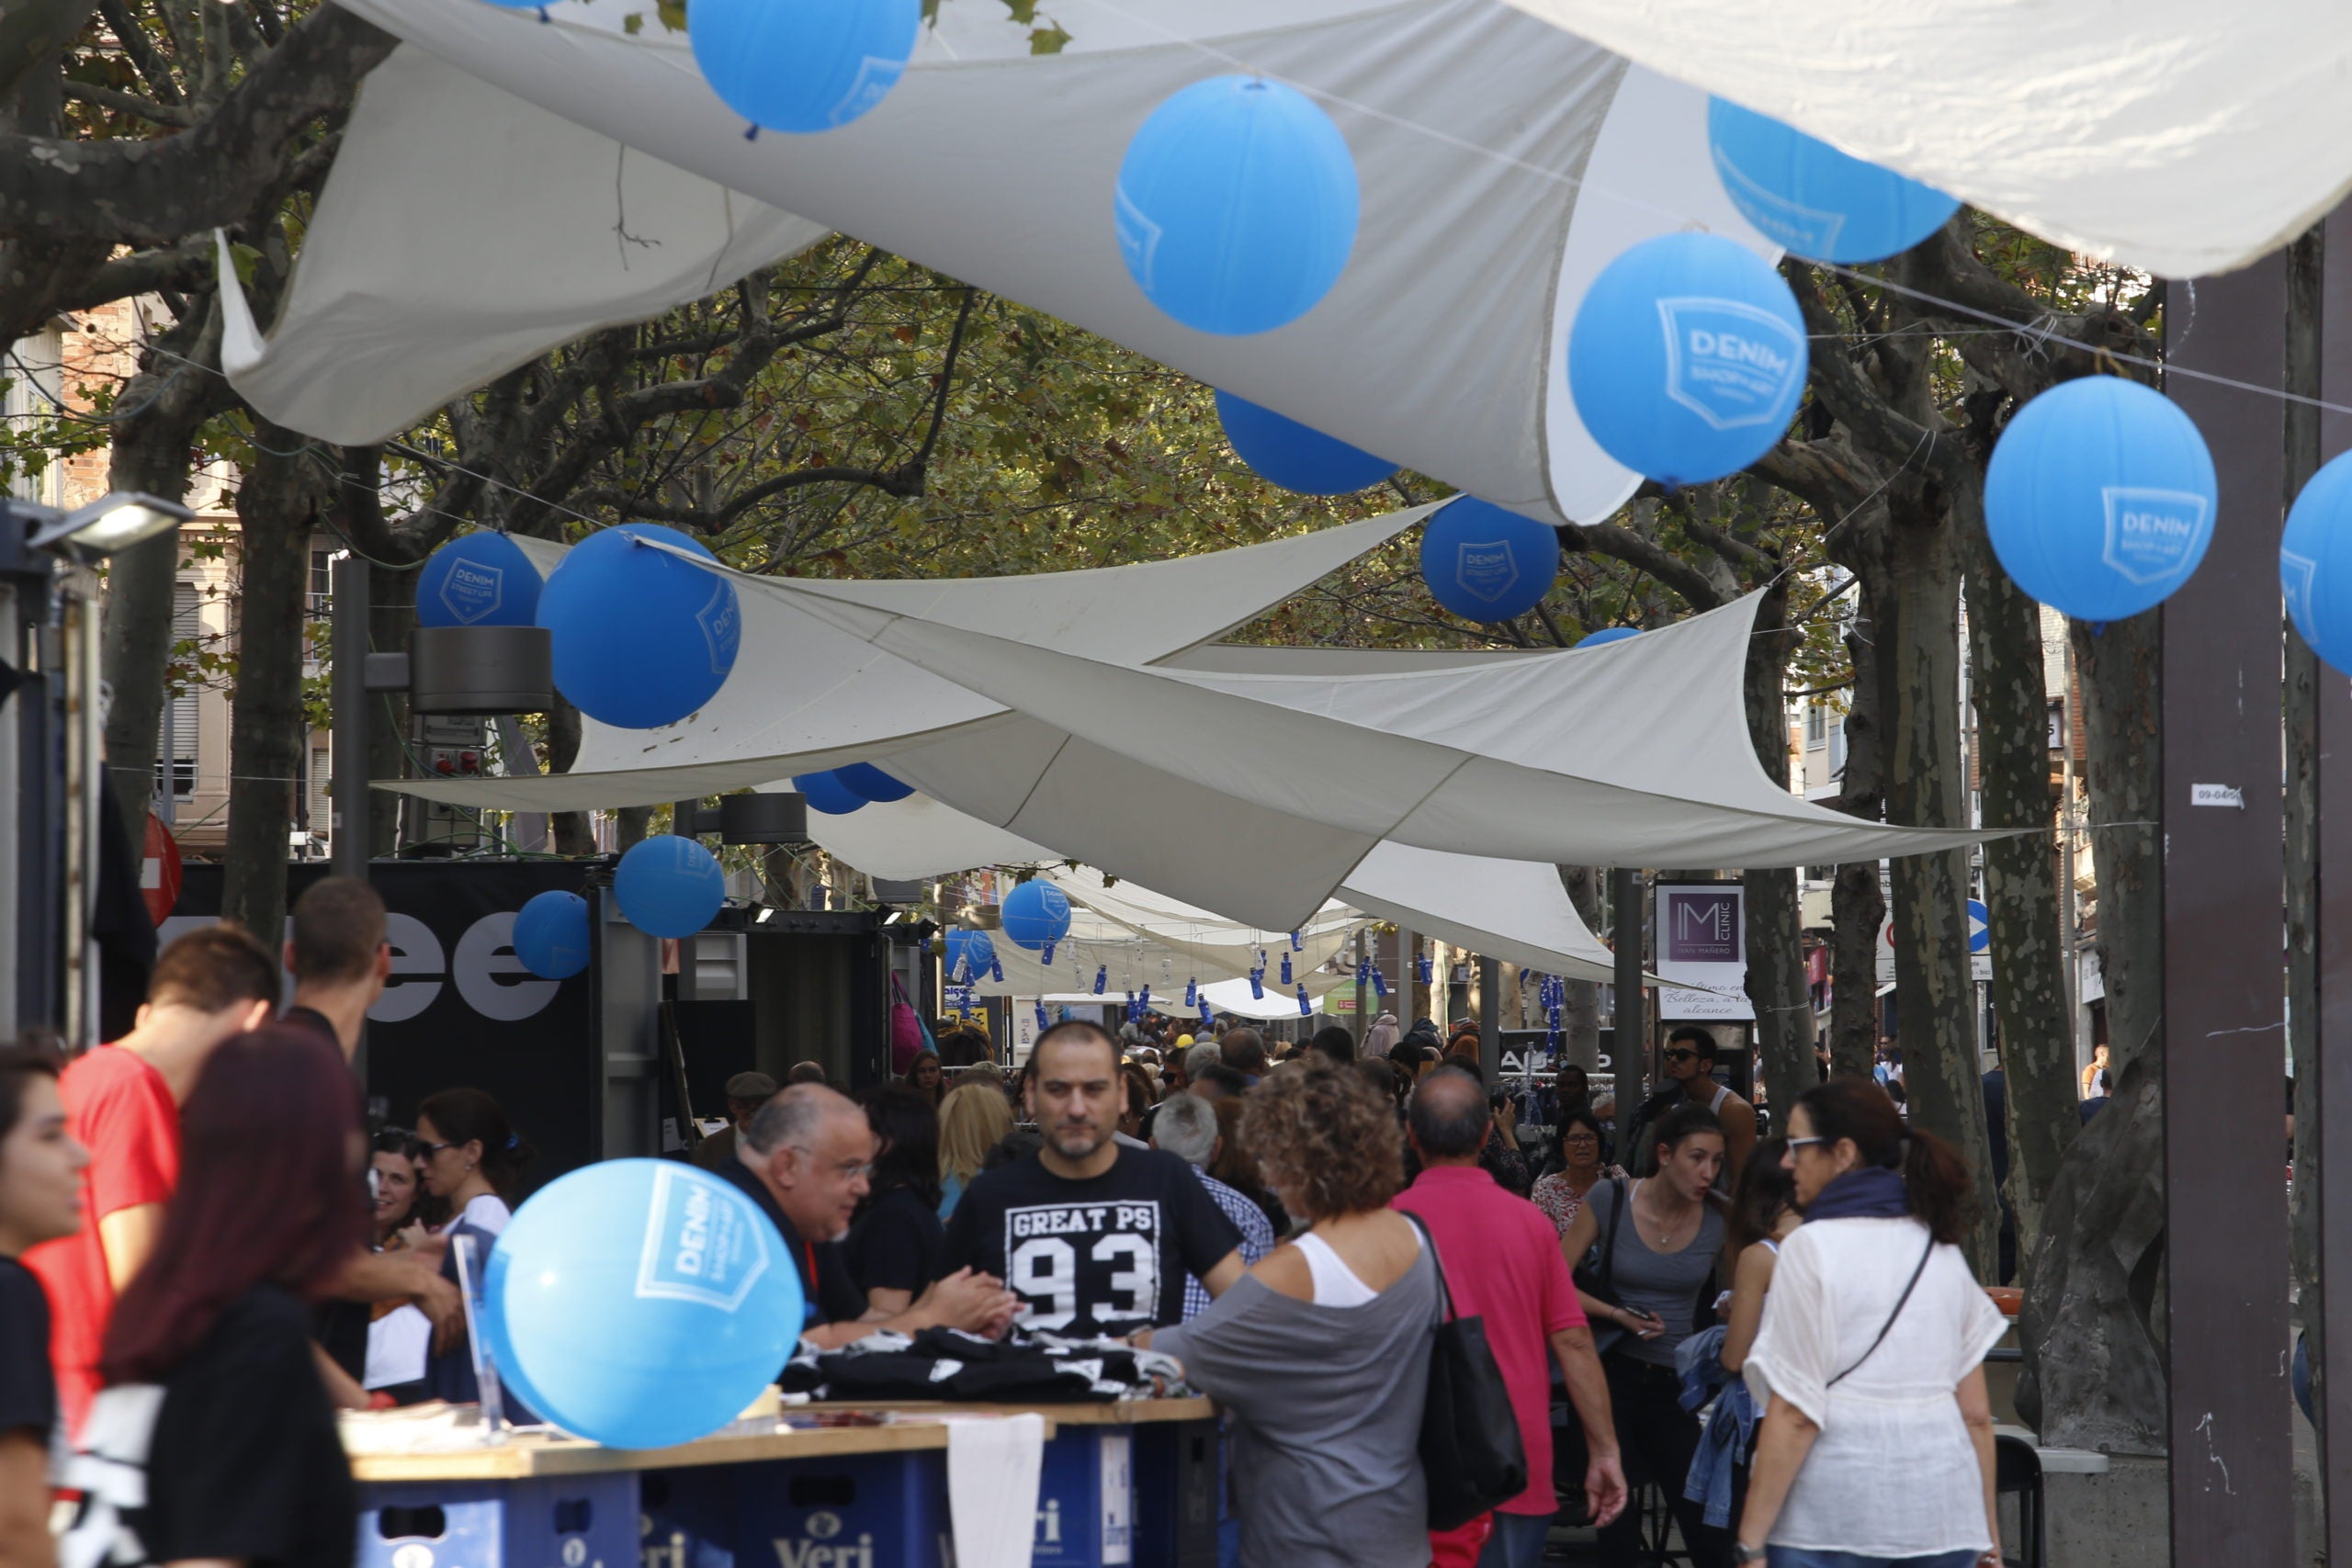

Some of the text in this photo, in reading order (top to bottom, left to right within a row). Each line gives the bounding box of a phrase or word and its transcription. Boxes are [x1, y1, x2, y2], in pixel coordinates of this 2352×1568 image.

[1689, 328, 1788, 378] DENIM
[456, 569, 494, 586] DENIM
[1720, 902, 1731, 941] CLINIC
[1013, 1206, 1152, 1237] GREAT PS
[1012, 1233, 1156, 1331] 93
